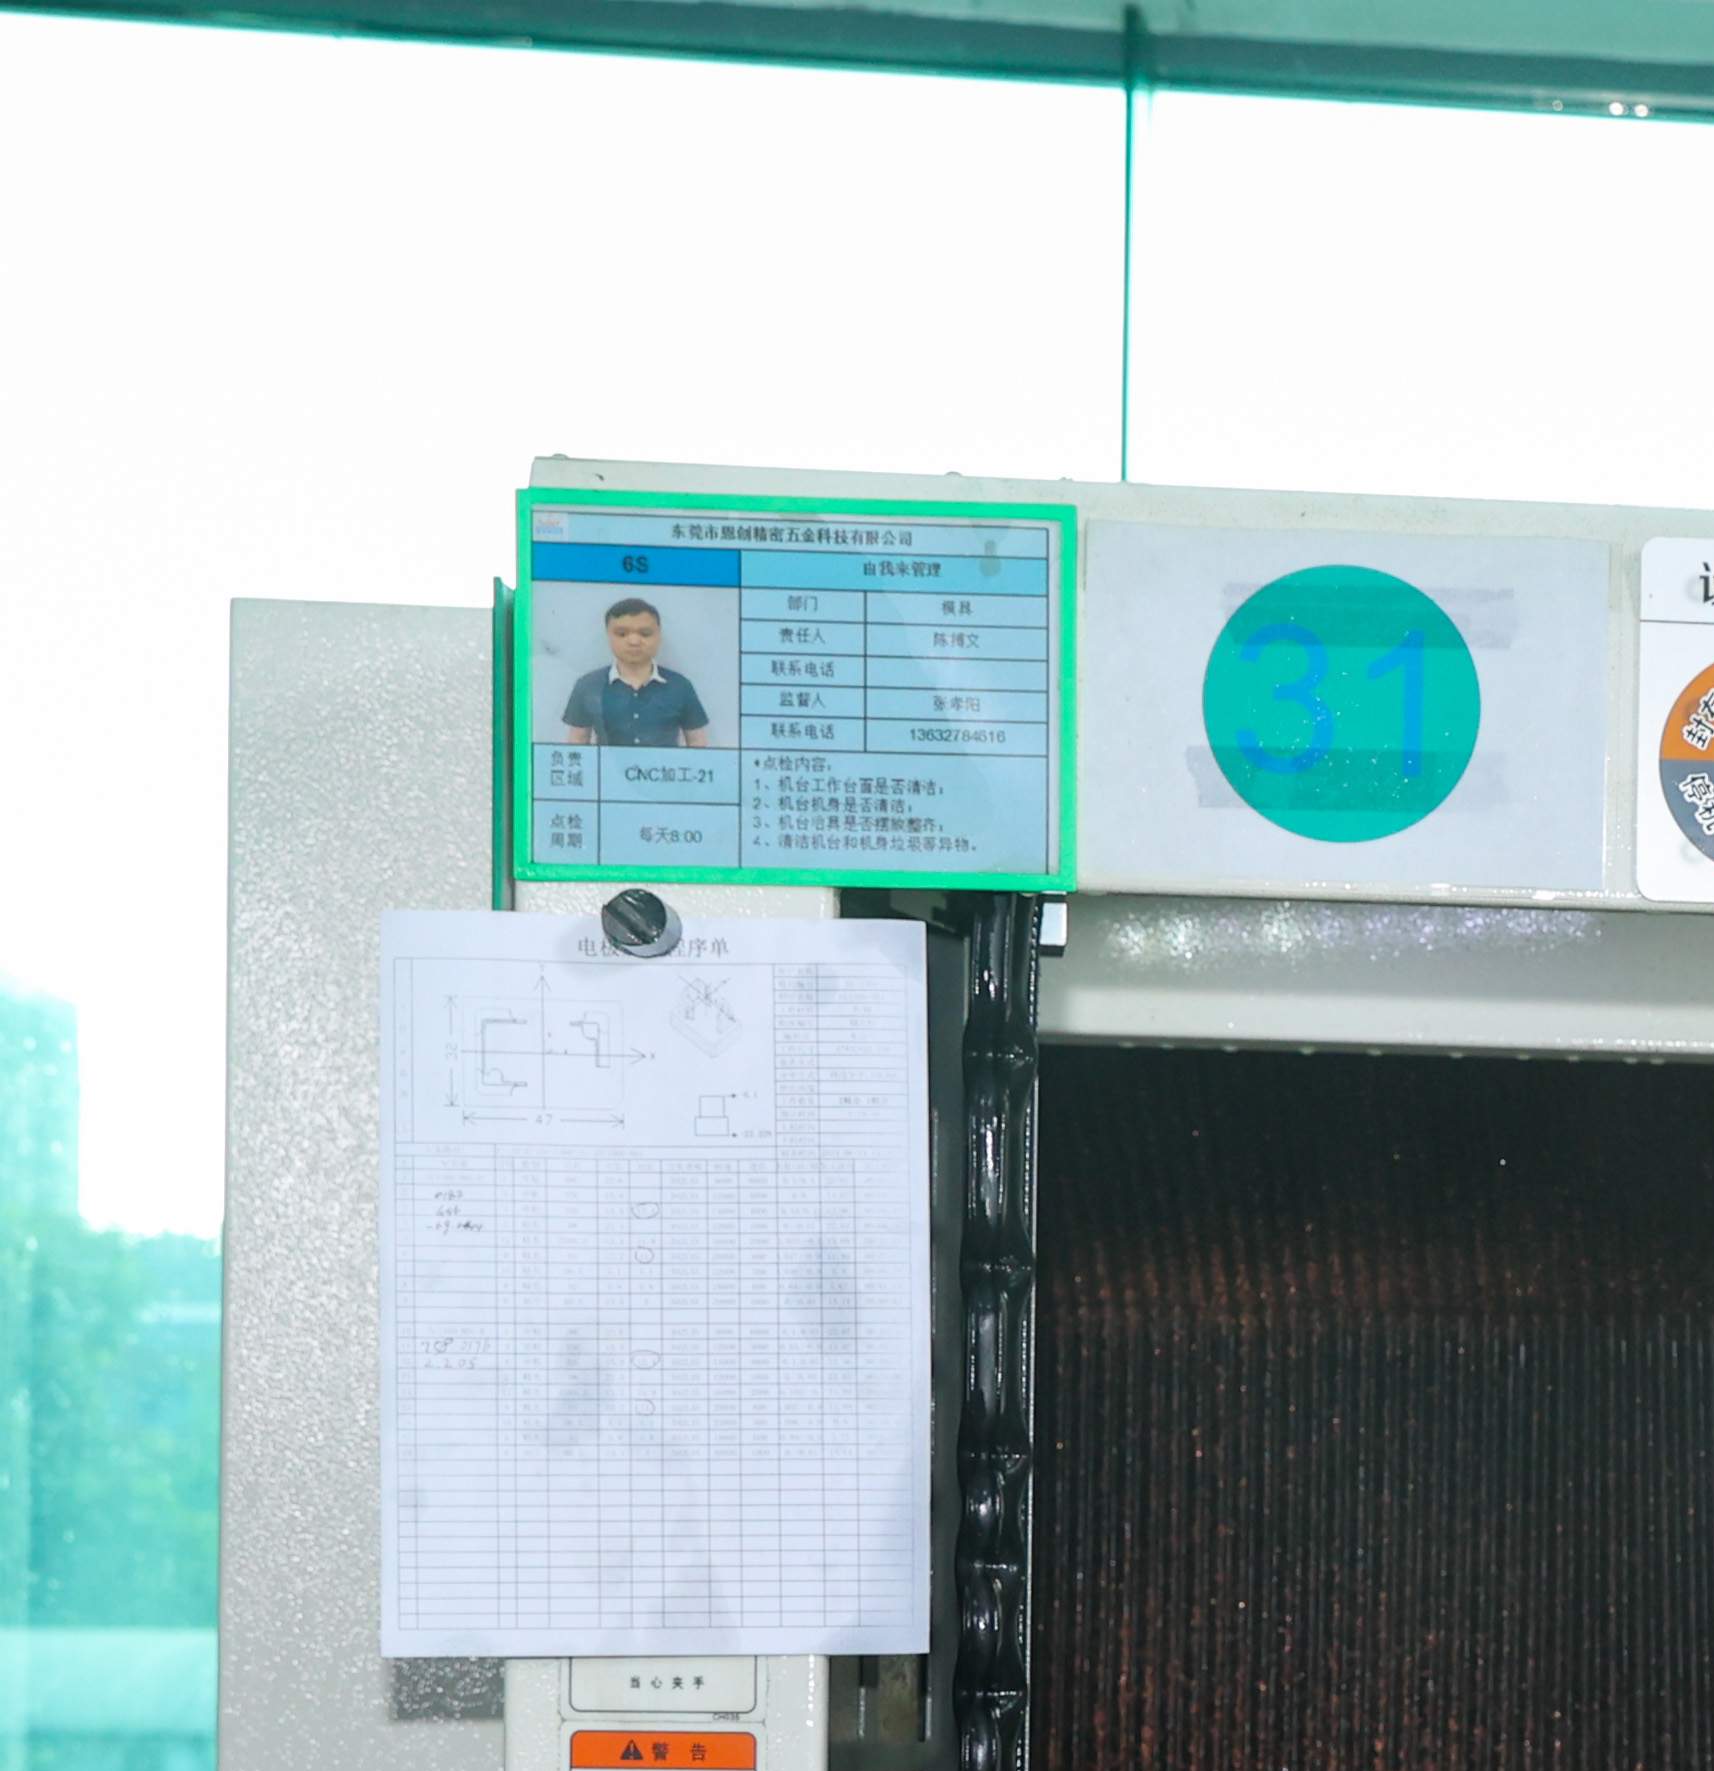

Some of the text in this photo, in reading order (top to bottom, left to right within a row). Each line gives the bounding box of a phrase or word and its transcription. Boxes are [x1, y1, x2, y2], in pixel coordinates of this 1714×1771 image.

[623, 557, 648, 574] 6S
[788, 595, 818, 612] 部门
[941, 600, 973, 616] 模具
[778, 626, 826, 646] 责任人
[771, 660, 835, 679] 联系电话
[780, 692, 826, 710] 监督人
[1235, 623, 1427, 777] 31
[770, 722, 835, 742] 联系电话
[550, 769, 584, 788] 区域
[550, 814, 583, 832] 点检
[550, 832, 583, 850] 周期
[630, 1677, 704, 1688] 当心夹手
[652, 1743, 706, 1762] 警告
